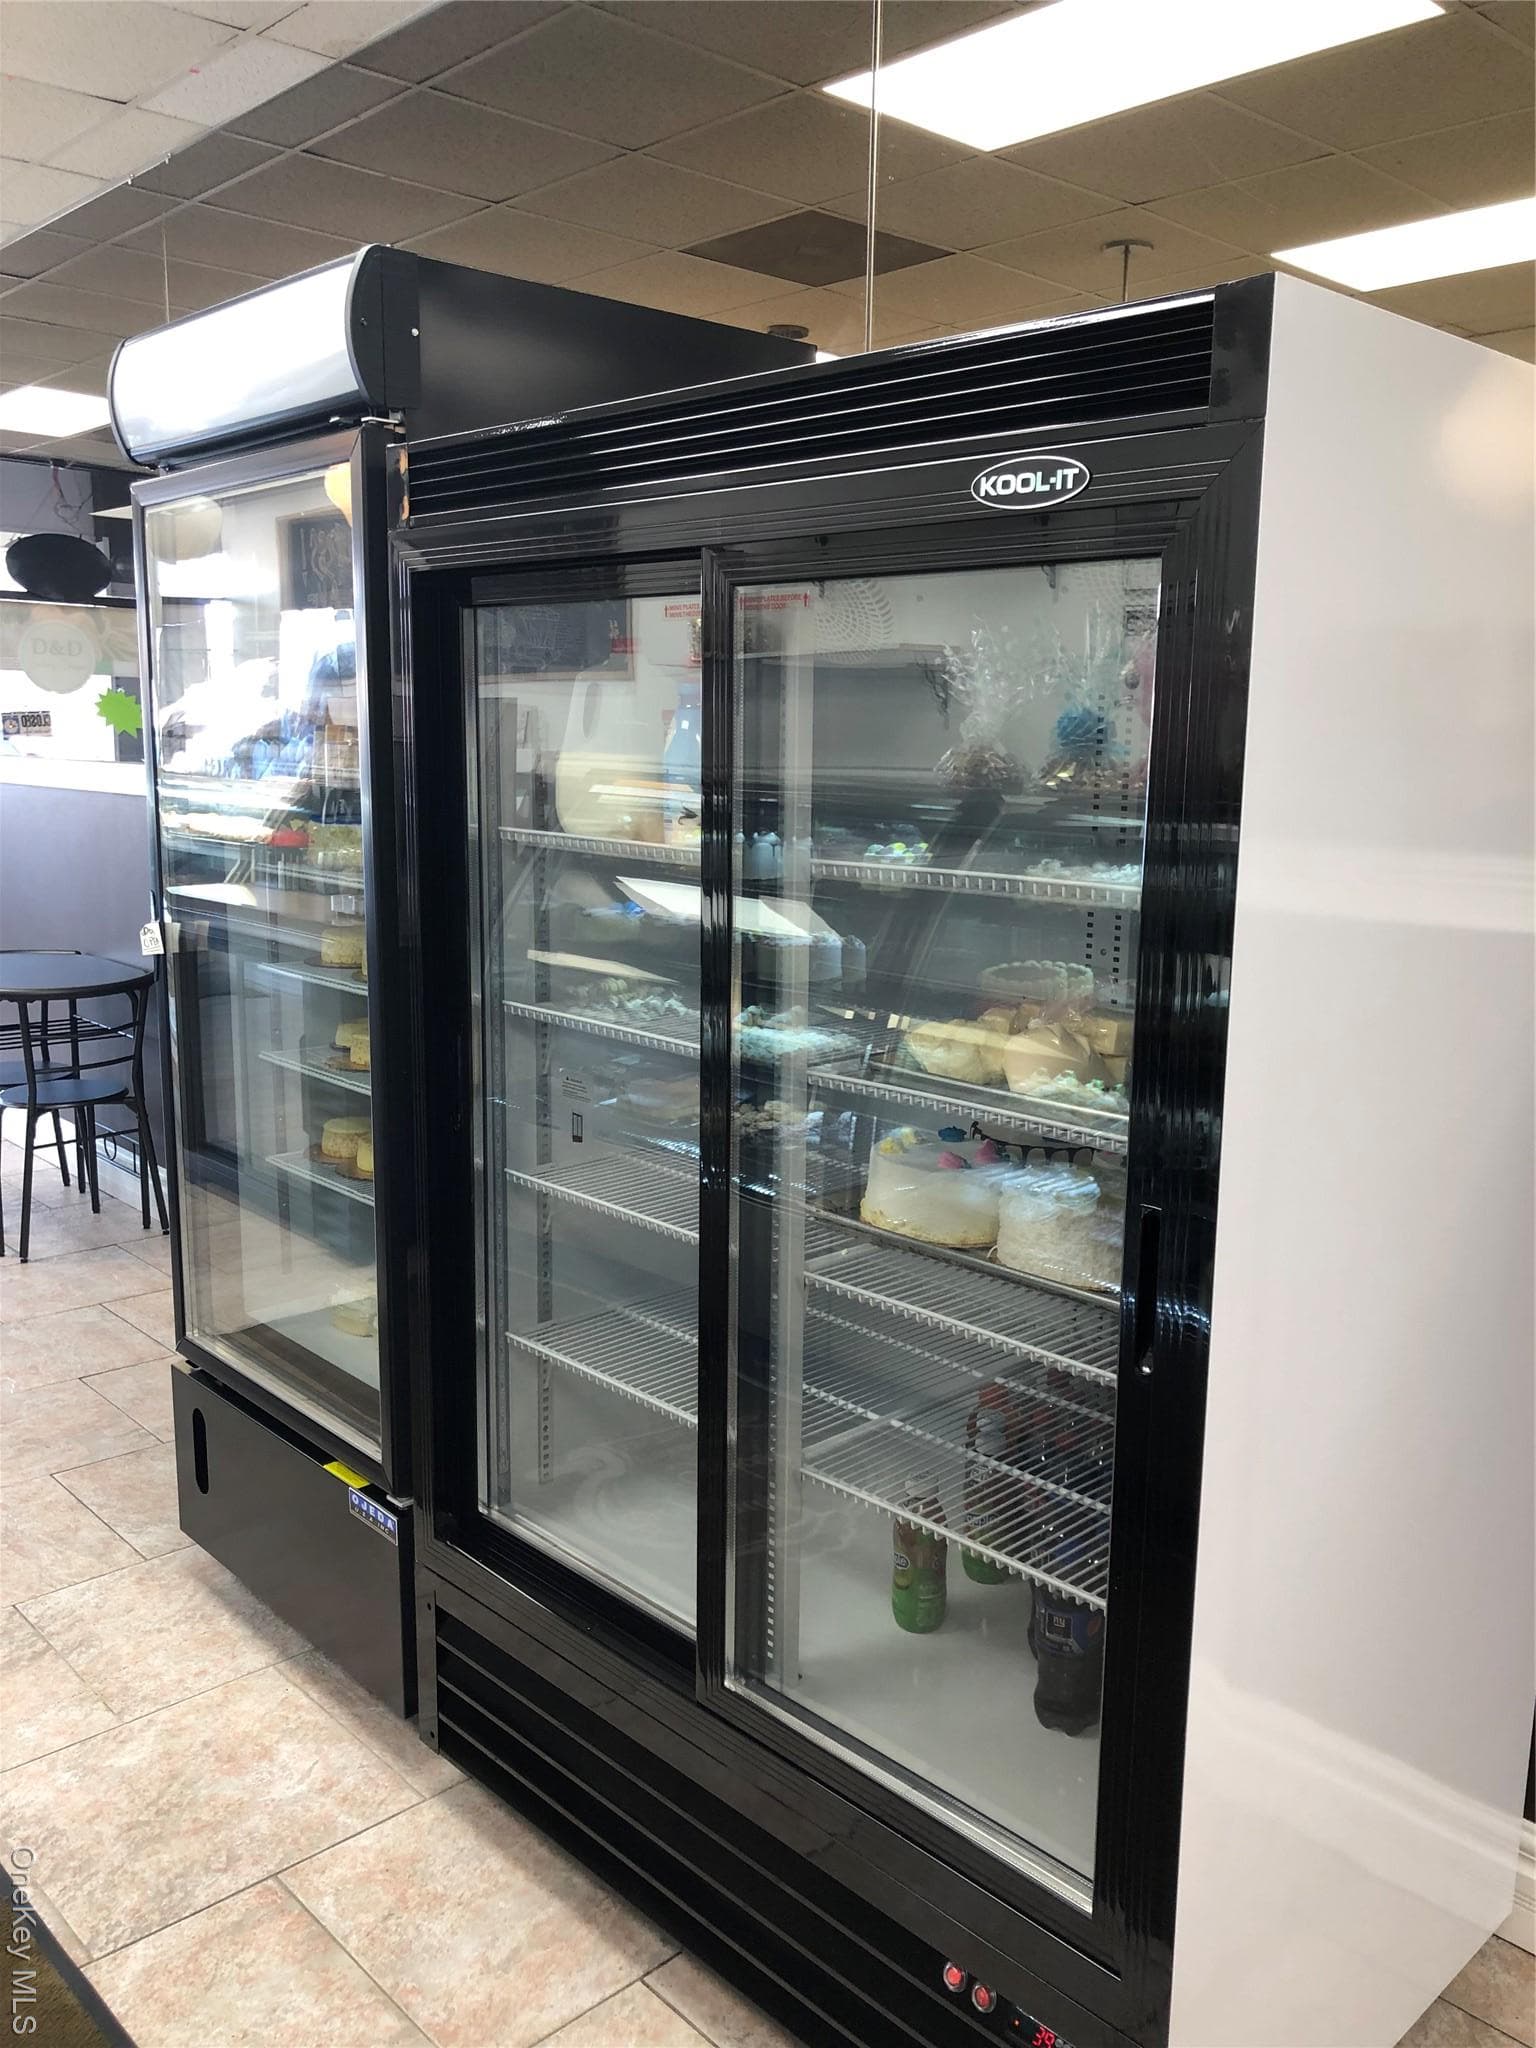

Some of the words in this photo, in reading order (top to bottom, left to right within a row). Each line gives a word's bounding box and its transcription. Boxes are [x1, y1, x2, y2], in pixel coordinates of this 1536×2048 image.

[979, 468, 1080, 497] KOOL-IT
[31, 638, 82, 657] D&D
[352, 1494, 394, 1531] OJEDA
